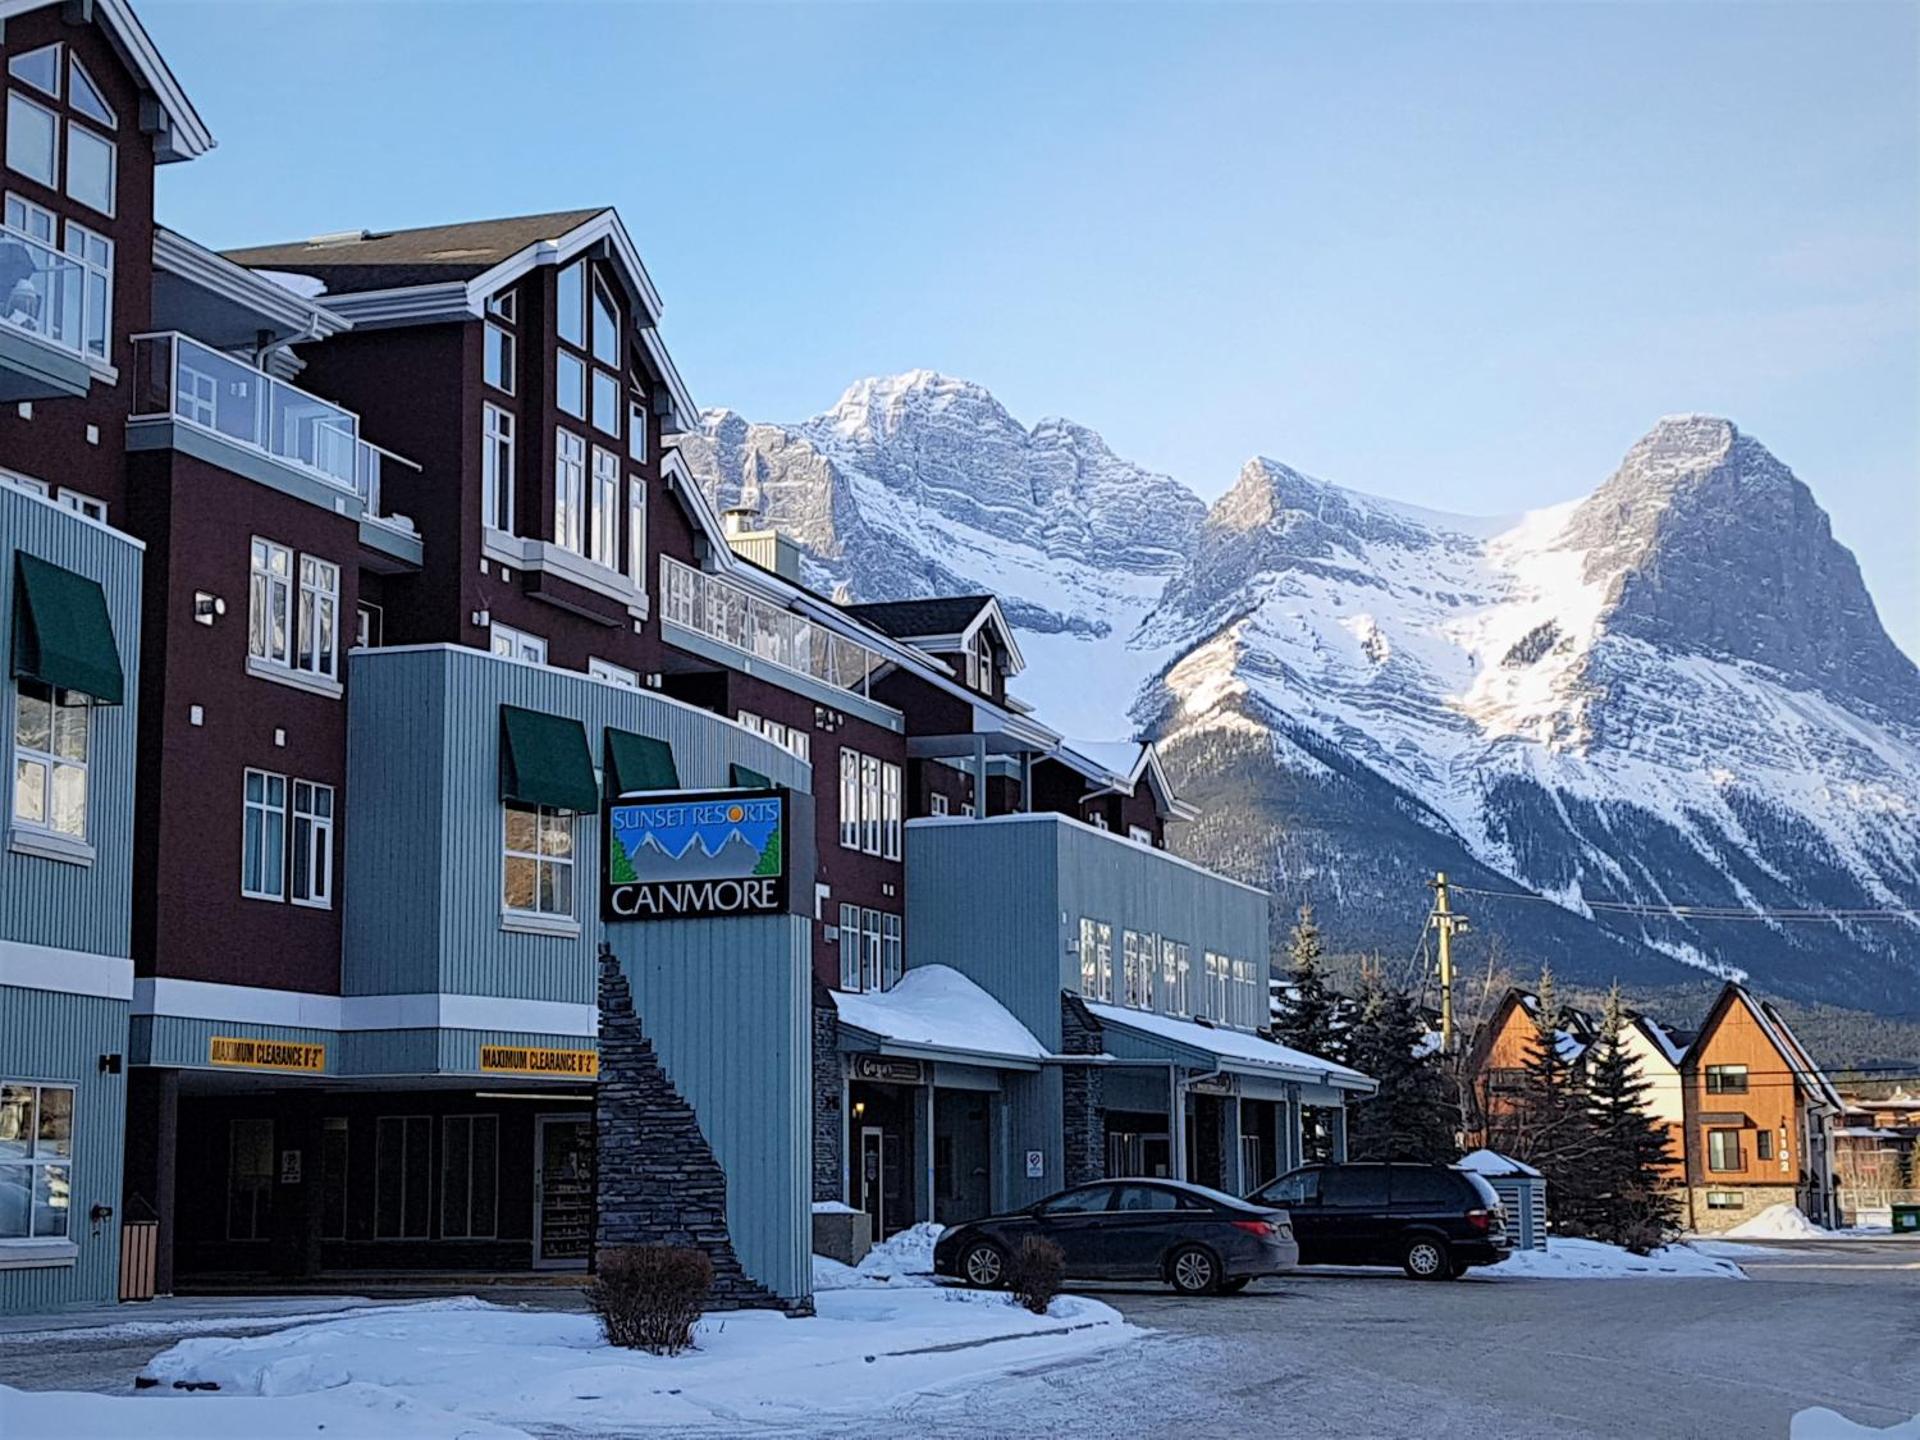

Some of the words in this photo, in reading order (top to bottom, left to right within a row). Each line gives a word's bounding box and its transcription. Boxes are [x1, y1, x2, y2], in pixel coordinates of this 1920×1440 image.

[613, 807, 687, 830] SUNSET
[692, 802, 778, 825] RESORTS
[611, 879, 778, 915] CANMORE
[211, 1040, 255, 1063] MAXIMUM
[256, 1044, 302, 1067] CLEARANCE
[482, 1048, 527, 1069] MAXIMUM
[529, 1051, 577, 1072] CLEARANCE
